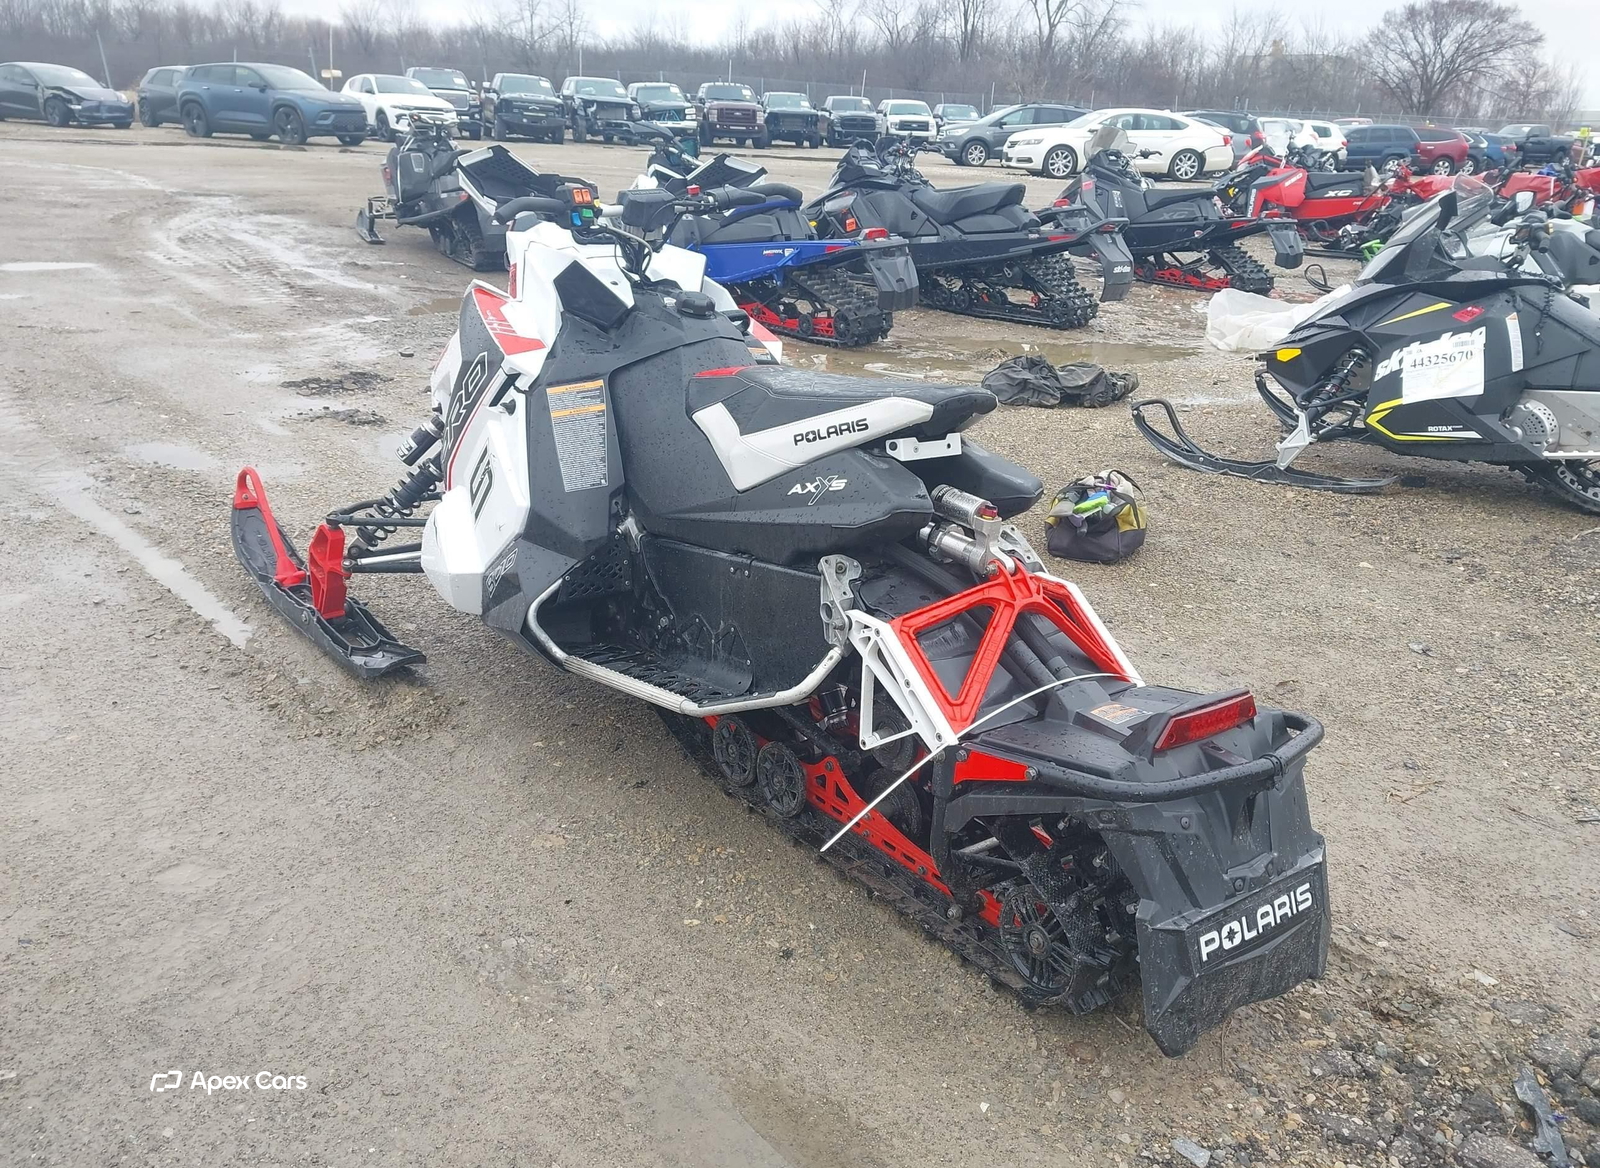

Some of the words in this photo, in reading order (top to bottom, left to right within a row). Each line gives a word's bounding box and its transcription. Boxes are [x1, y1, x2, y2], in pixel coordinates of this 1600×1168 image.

[1324, 189, 1352, 197] XC
[1410, 350, 1473, 368] 44325670
[794, 418, 869, 446] POLARIS
[787, 475, 848, 505] AXYS
[1200, 882, 1312, 962] POLARIS
